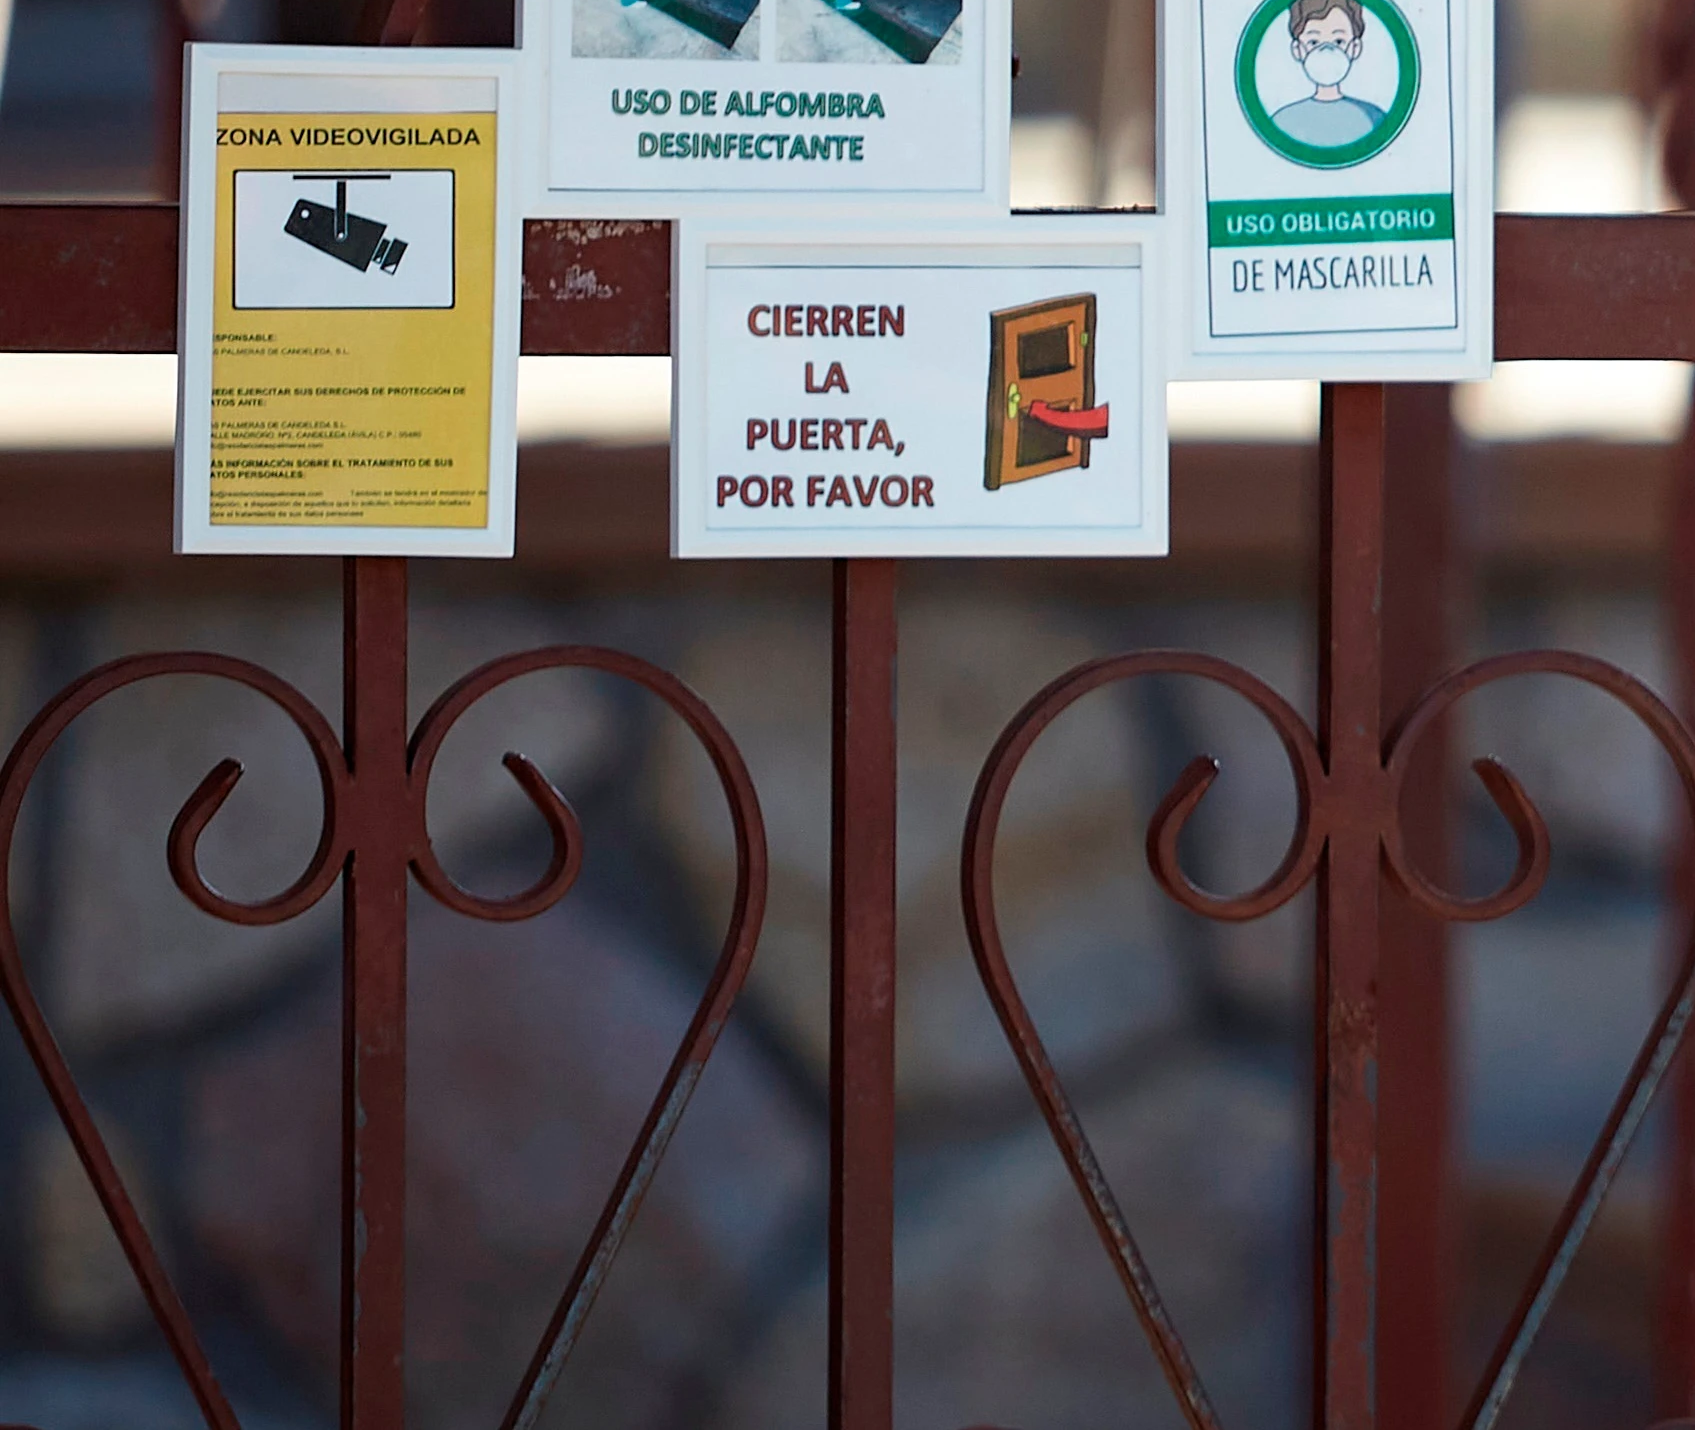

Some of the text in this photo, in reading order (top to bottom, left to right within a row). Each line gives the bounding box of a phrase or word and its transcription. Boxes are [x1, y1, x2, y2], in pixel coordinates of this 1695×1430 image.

[612, 89, 885, 118] USO DE ALFOMBRA
[216, 128, 481, 146] ZONA VIDEOVIGILADA
[639, 132, 864, 161] DESINFECTANTE
[1227, 209, 1434, 235] USO OBLIGATORIO
[1233, 254, 1433, 292] DE MASCARILLA
[748, 305, 904, 337] CIERREN
[237, 387, 290, 396] EJERCITAR
[294, 387, 313, 396] SUS
[316, 387, 369, 396] DERECHOS
[371, 387, 383, 396] DE
[805, 362, 849, 394] LA
[747, 419, 905, 457] PUERTA,
[297, 459, 330, 468] SOBRE
[333, 459, 344, 468] EL
[347, 458, 416, 468] TRATAMIENTO
[419, 458, 431, 468] DE
[717, 475, 934, 508] POR FAVOR
